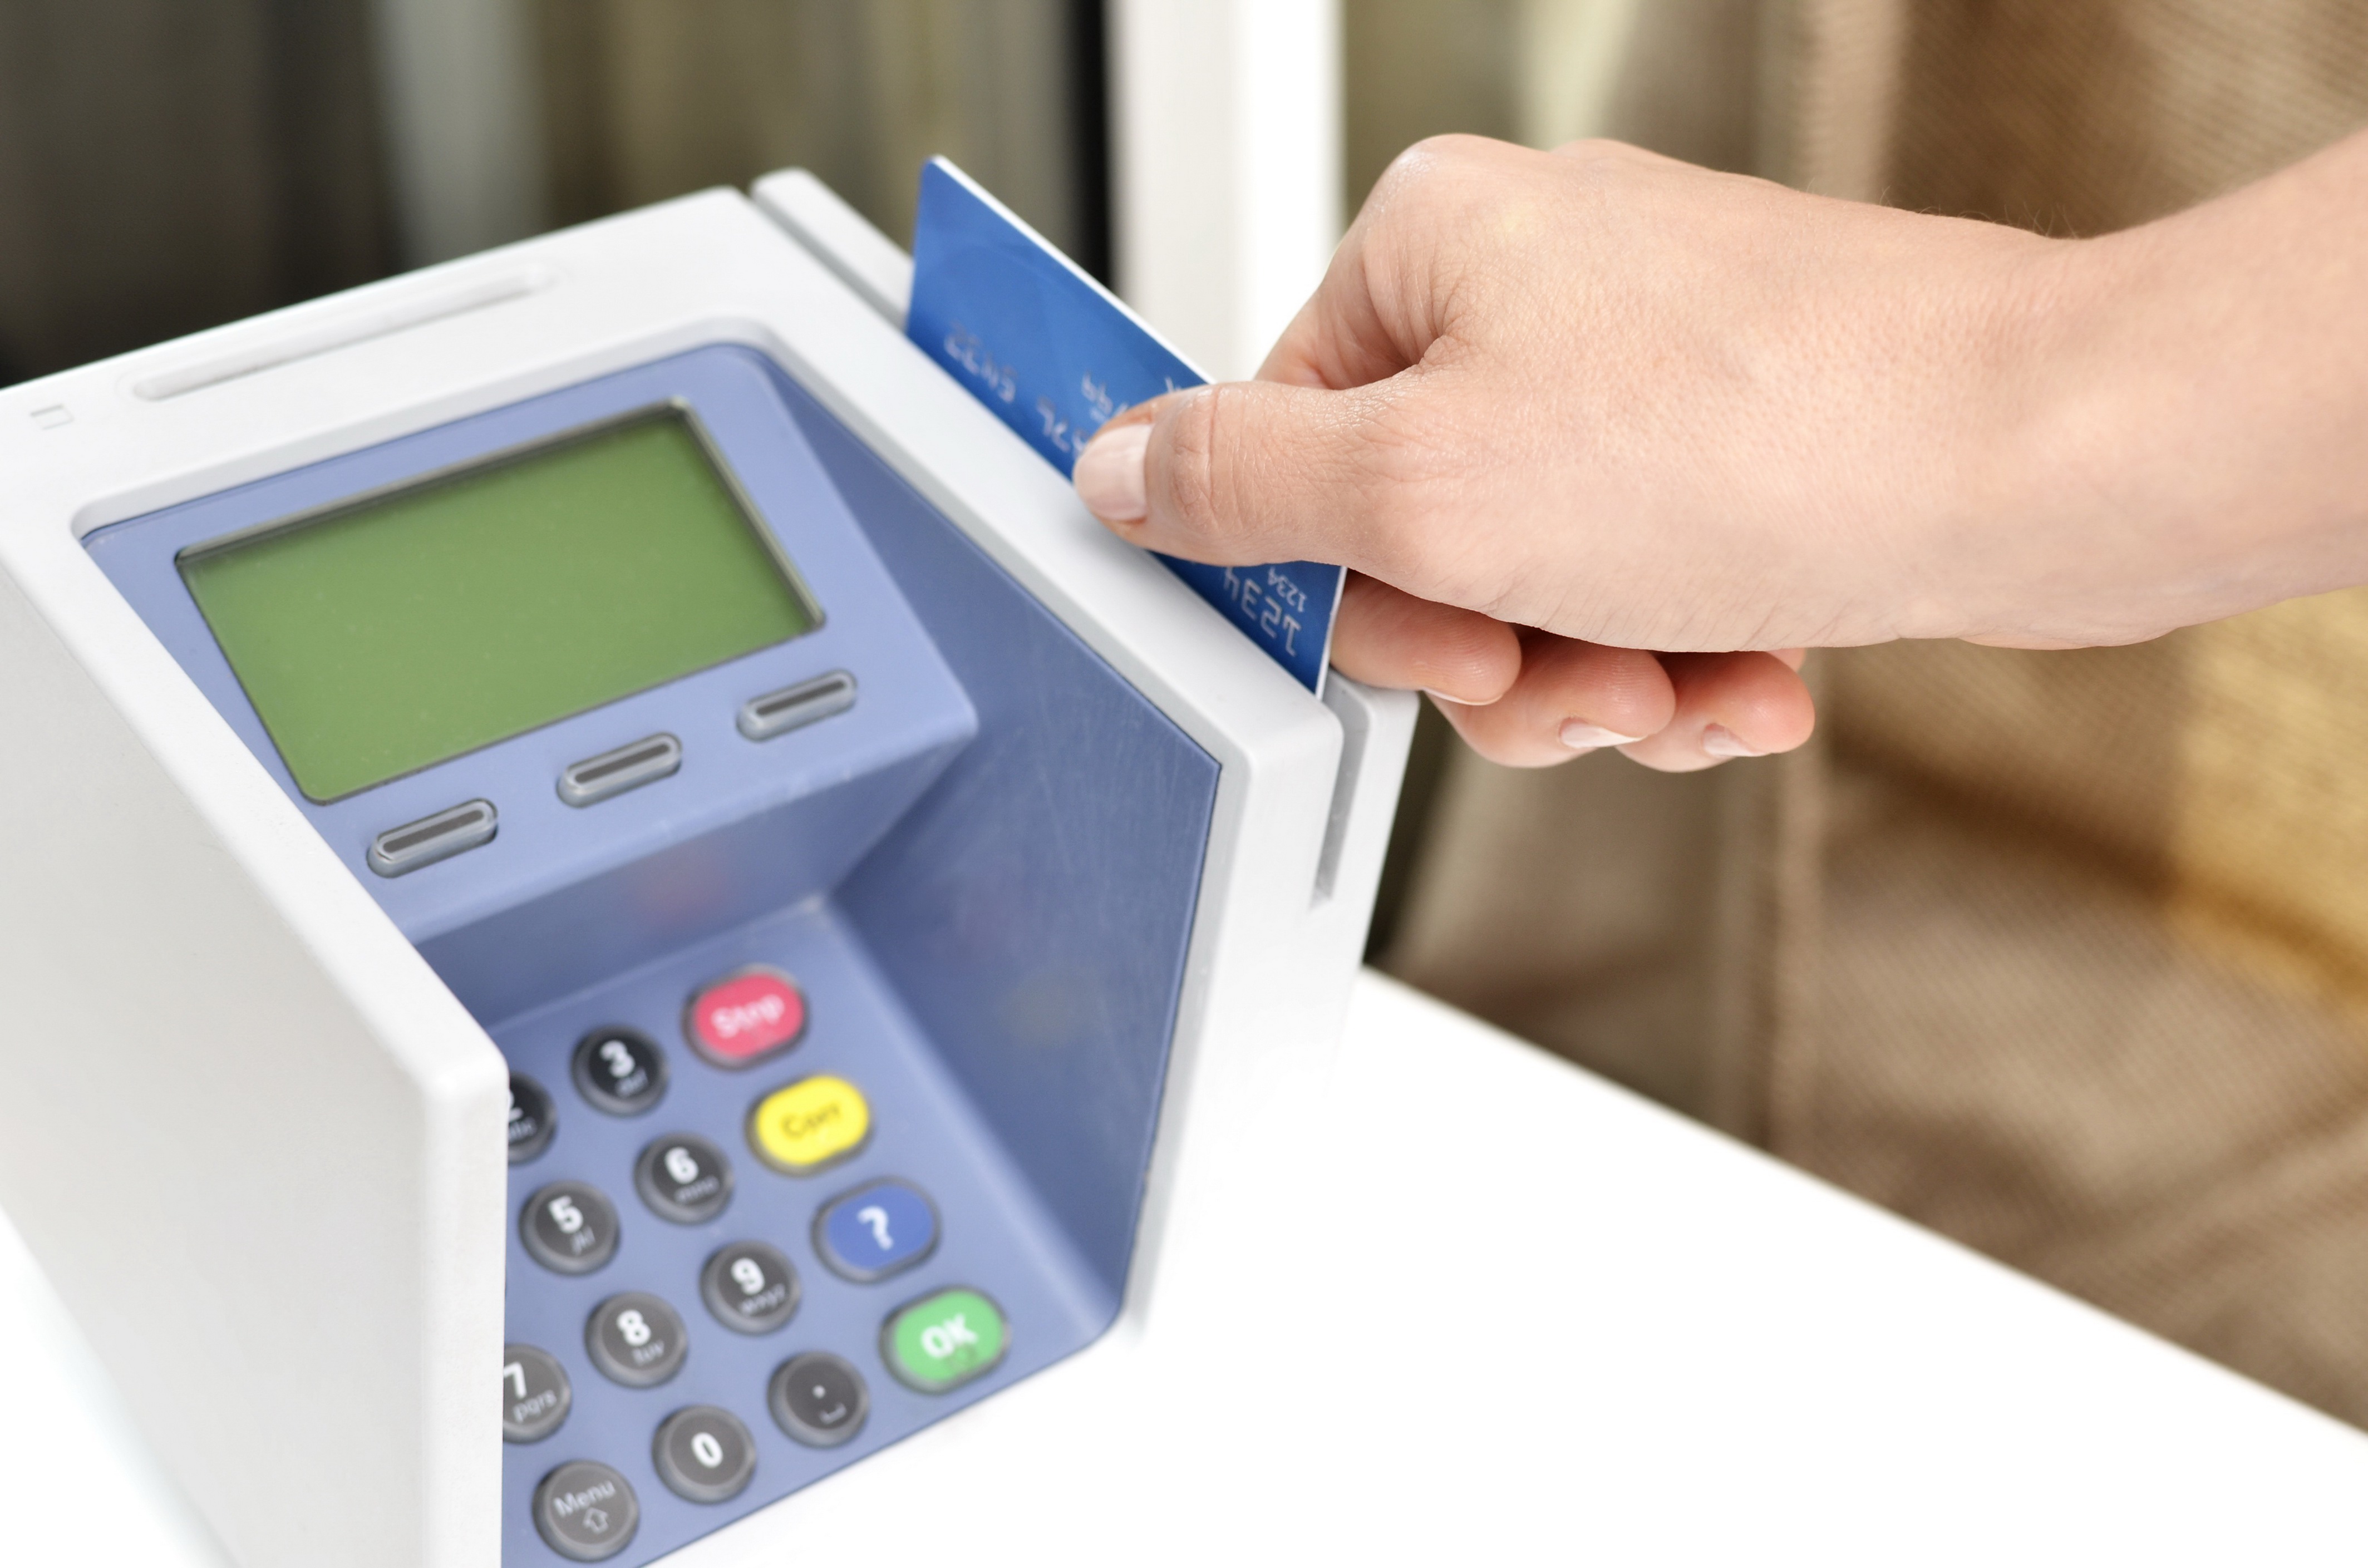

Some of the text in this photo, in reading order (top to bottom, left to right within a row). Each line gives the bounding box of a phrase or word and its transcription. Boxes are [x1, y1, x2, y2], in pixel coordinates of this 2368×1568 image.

[1268, 566, 1308, 612] 1234
[1225, 566, 1302, 657] 1234
[600, 1039, 636, 1078] 3
[664, 1146, 700, 1184] 6
[548, 1195, 584, 1234] 5
[856, 1205, 894, 1250] ?
[730, 1257, 765, 1296] 9
[616, 1309, 652, 1347] 8
[920, 1312, 978, 1359] OK
[503, 1361, 527, 1399] 7
[513, 1389, 557, 1423] pqrs
[690, 1431, 723, 1469] 0
[554, 1480, 616, 1518] Menu
